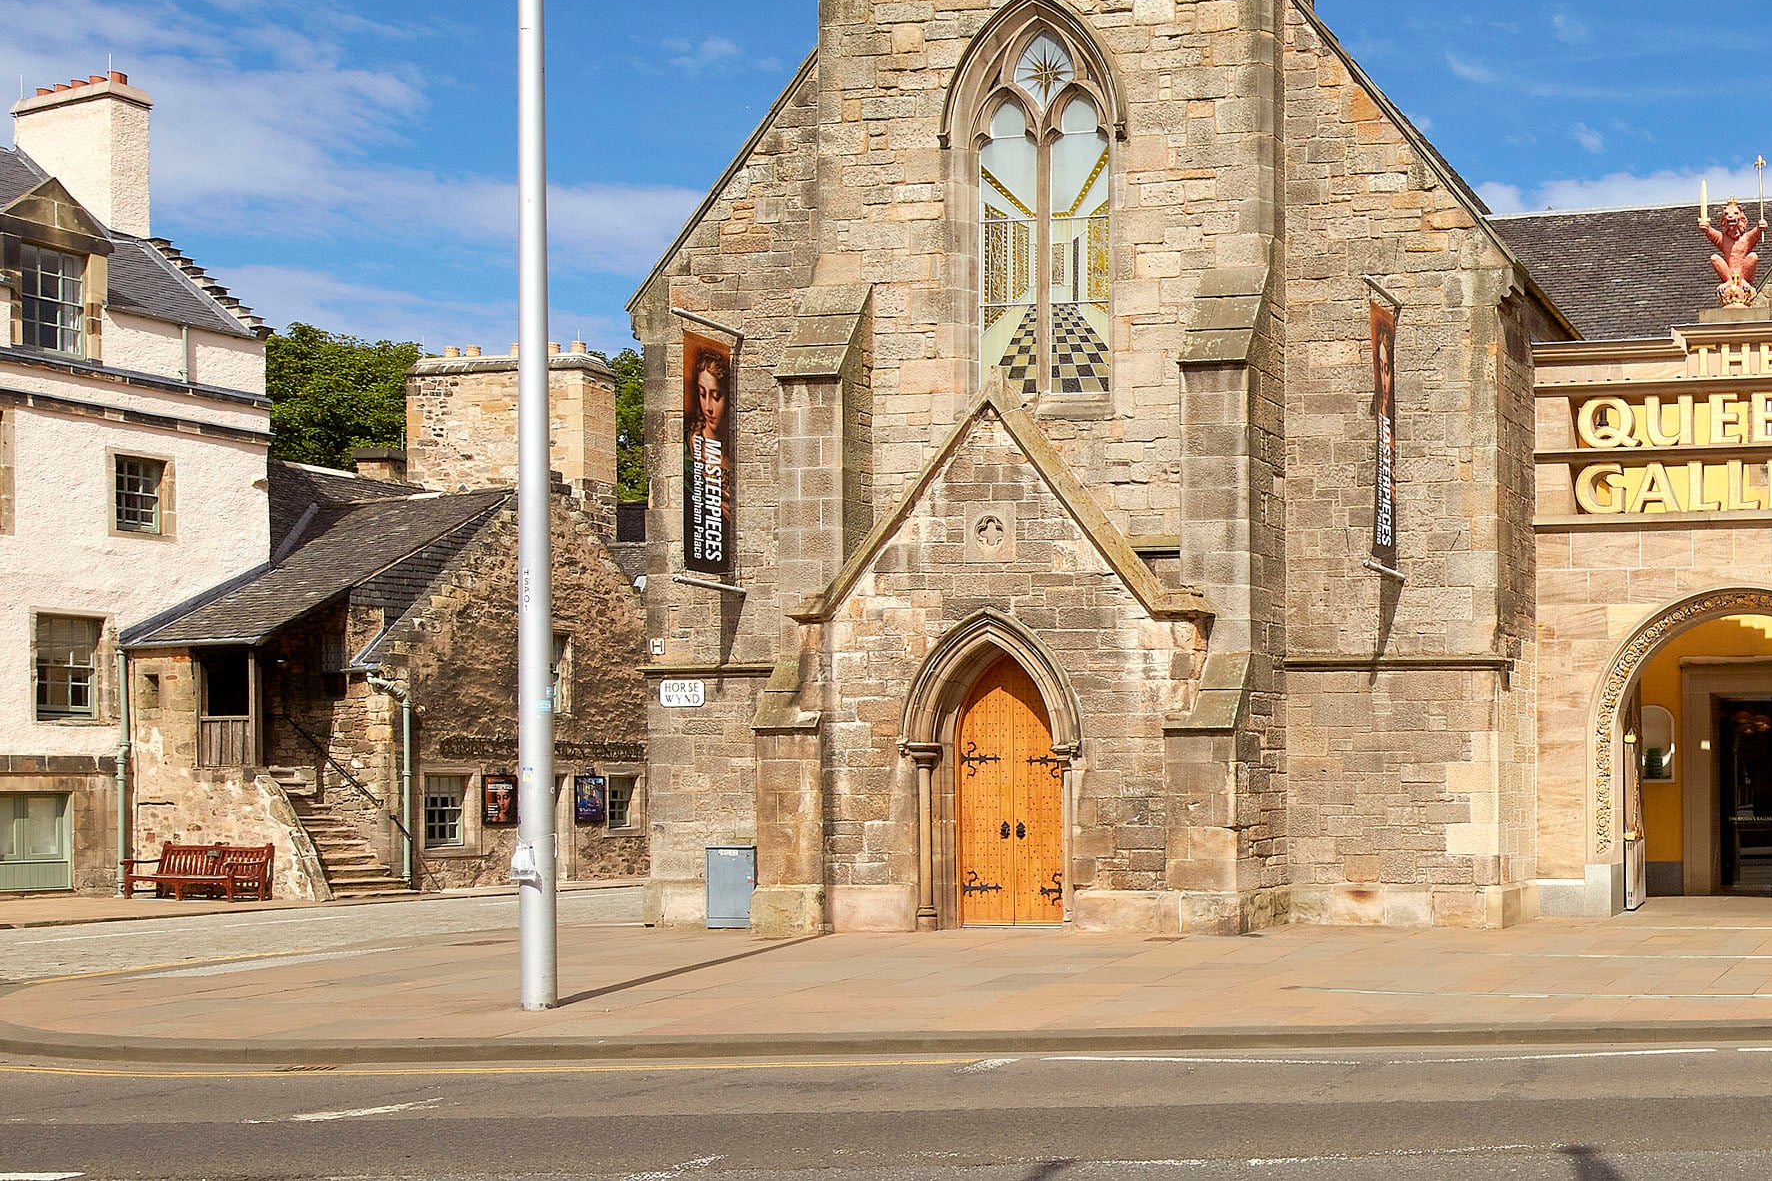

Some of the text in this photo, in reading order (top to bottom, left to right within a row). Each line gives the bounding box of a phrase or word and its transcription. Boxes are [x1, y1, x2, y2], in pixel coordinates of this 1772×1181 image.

[692, 435, 704, 560] from Buckingham Palace
[705, 438, 722, 562] MASTERPIECES
[1381, 415, 1392, 547] MASTERPIECES
[664, 682, 699, 692] HORSE
[665, 694, 700, 704] WYND
